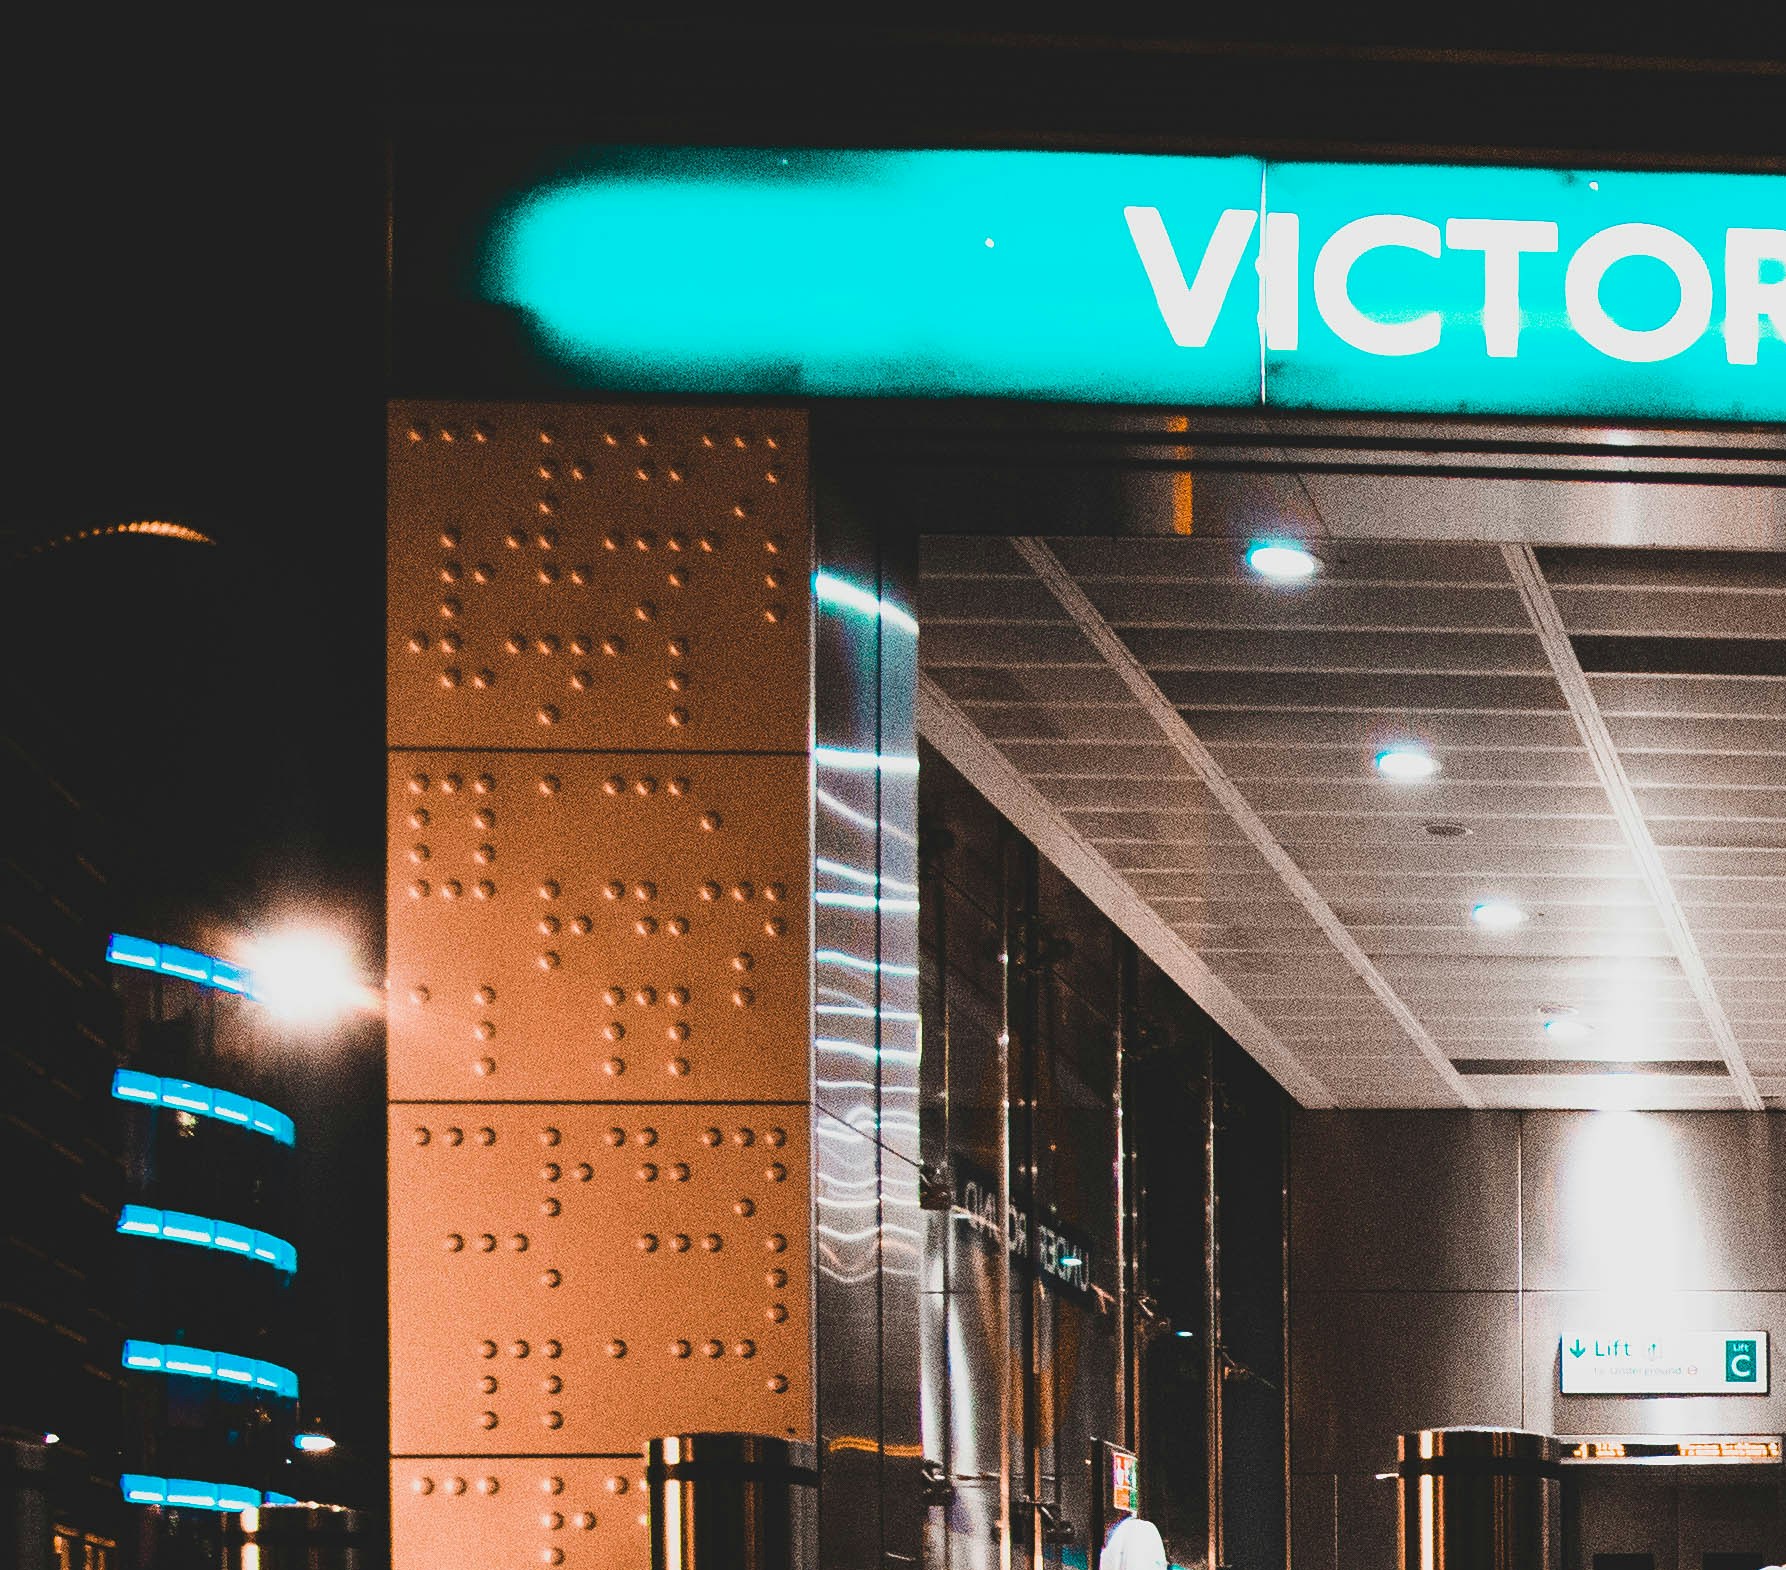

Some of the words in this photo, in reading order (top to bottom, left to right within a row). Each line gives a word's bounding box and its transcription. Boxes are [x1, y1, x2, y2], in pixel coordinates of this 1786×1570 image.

[1595, 1339, 1631, 1357] Lift
[1732, 1343, 1750, 1353] Lift
[1731, 1354, 1751, 1378] C
